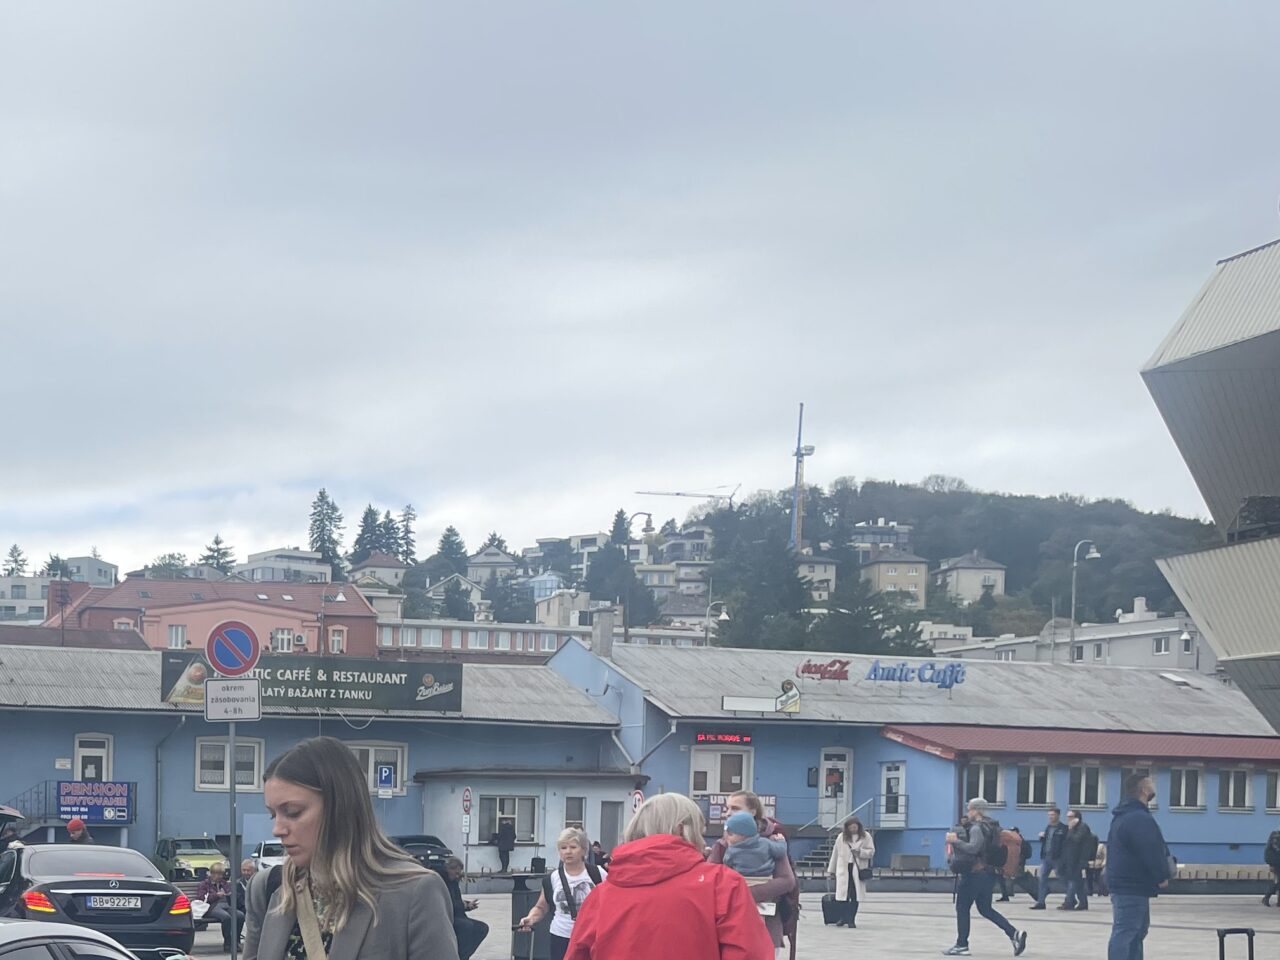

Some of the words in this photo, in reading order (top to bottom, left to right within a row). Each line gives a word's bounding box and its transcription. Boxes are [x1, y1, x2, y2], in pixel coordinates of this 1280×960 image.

[277, 667, 310, 681] CAFFÉ
[317, 669, 327, 681] &
[333, 671, 407, 685] RESTAURANT
[221, 684, 245, 692] okrem
[261, 686, 285, 697] LATÝ
[288, 687, 327, 698] BAŽANT
[330, 690, 336, 698] Z
[338, 690, 372, 700] TANKU
[211, 694, 256, 704] zásobovania
[382, 768, 389, 780] P
[60, 783, 128, 796] PENSION
